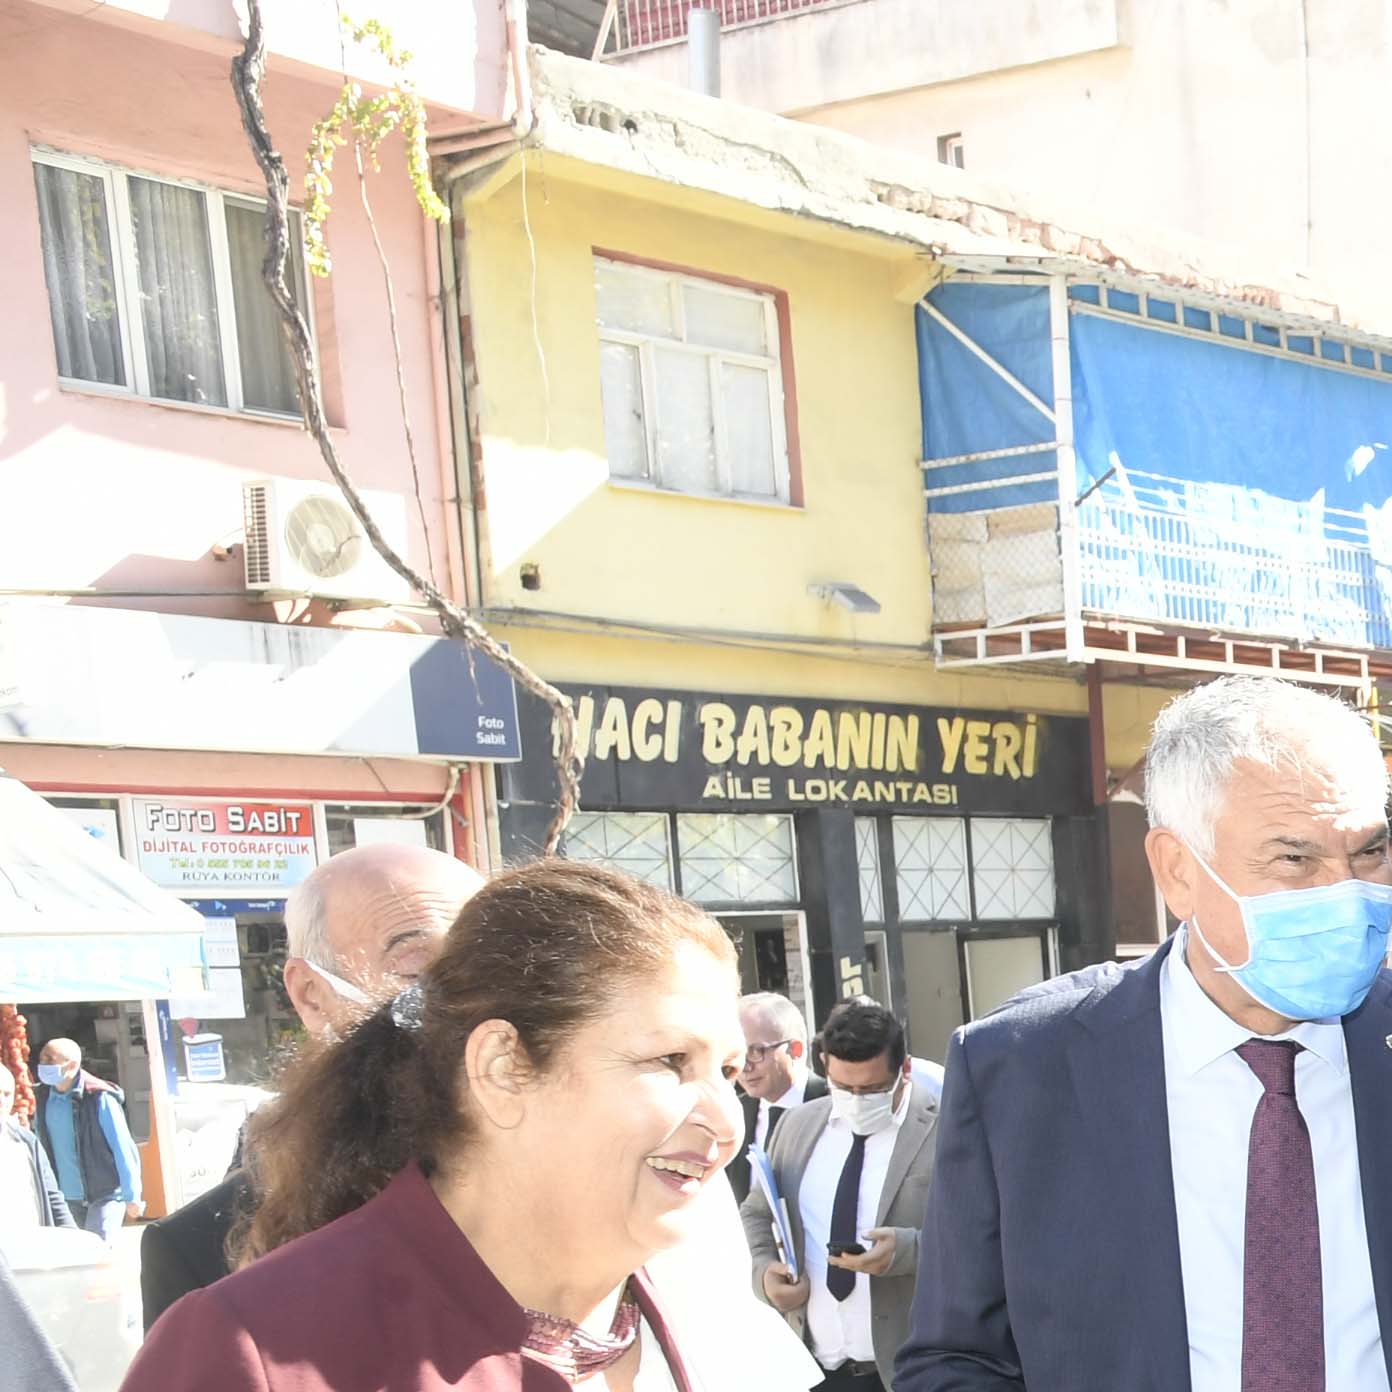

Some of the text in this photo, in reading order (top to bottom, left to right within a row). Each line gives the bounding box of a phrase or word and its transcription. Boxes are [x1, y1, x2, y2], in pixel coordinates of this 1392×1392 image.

[478, 715, 505, 729] Foto
[476, 731, 506, 745] Sabit
[701, 702, 919, 773] BABANIN
[936, 713, 1040, 780] YERİ
[702, 771, 958, 805] AİLE LOKANTASI
[143, 839, 310, 857] DİJİTAL FOTOĞRAFÇILIK
